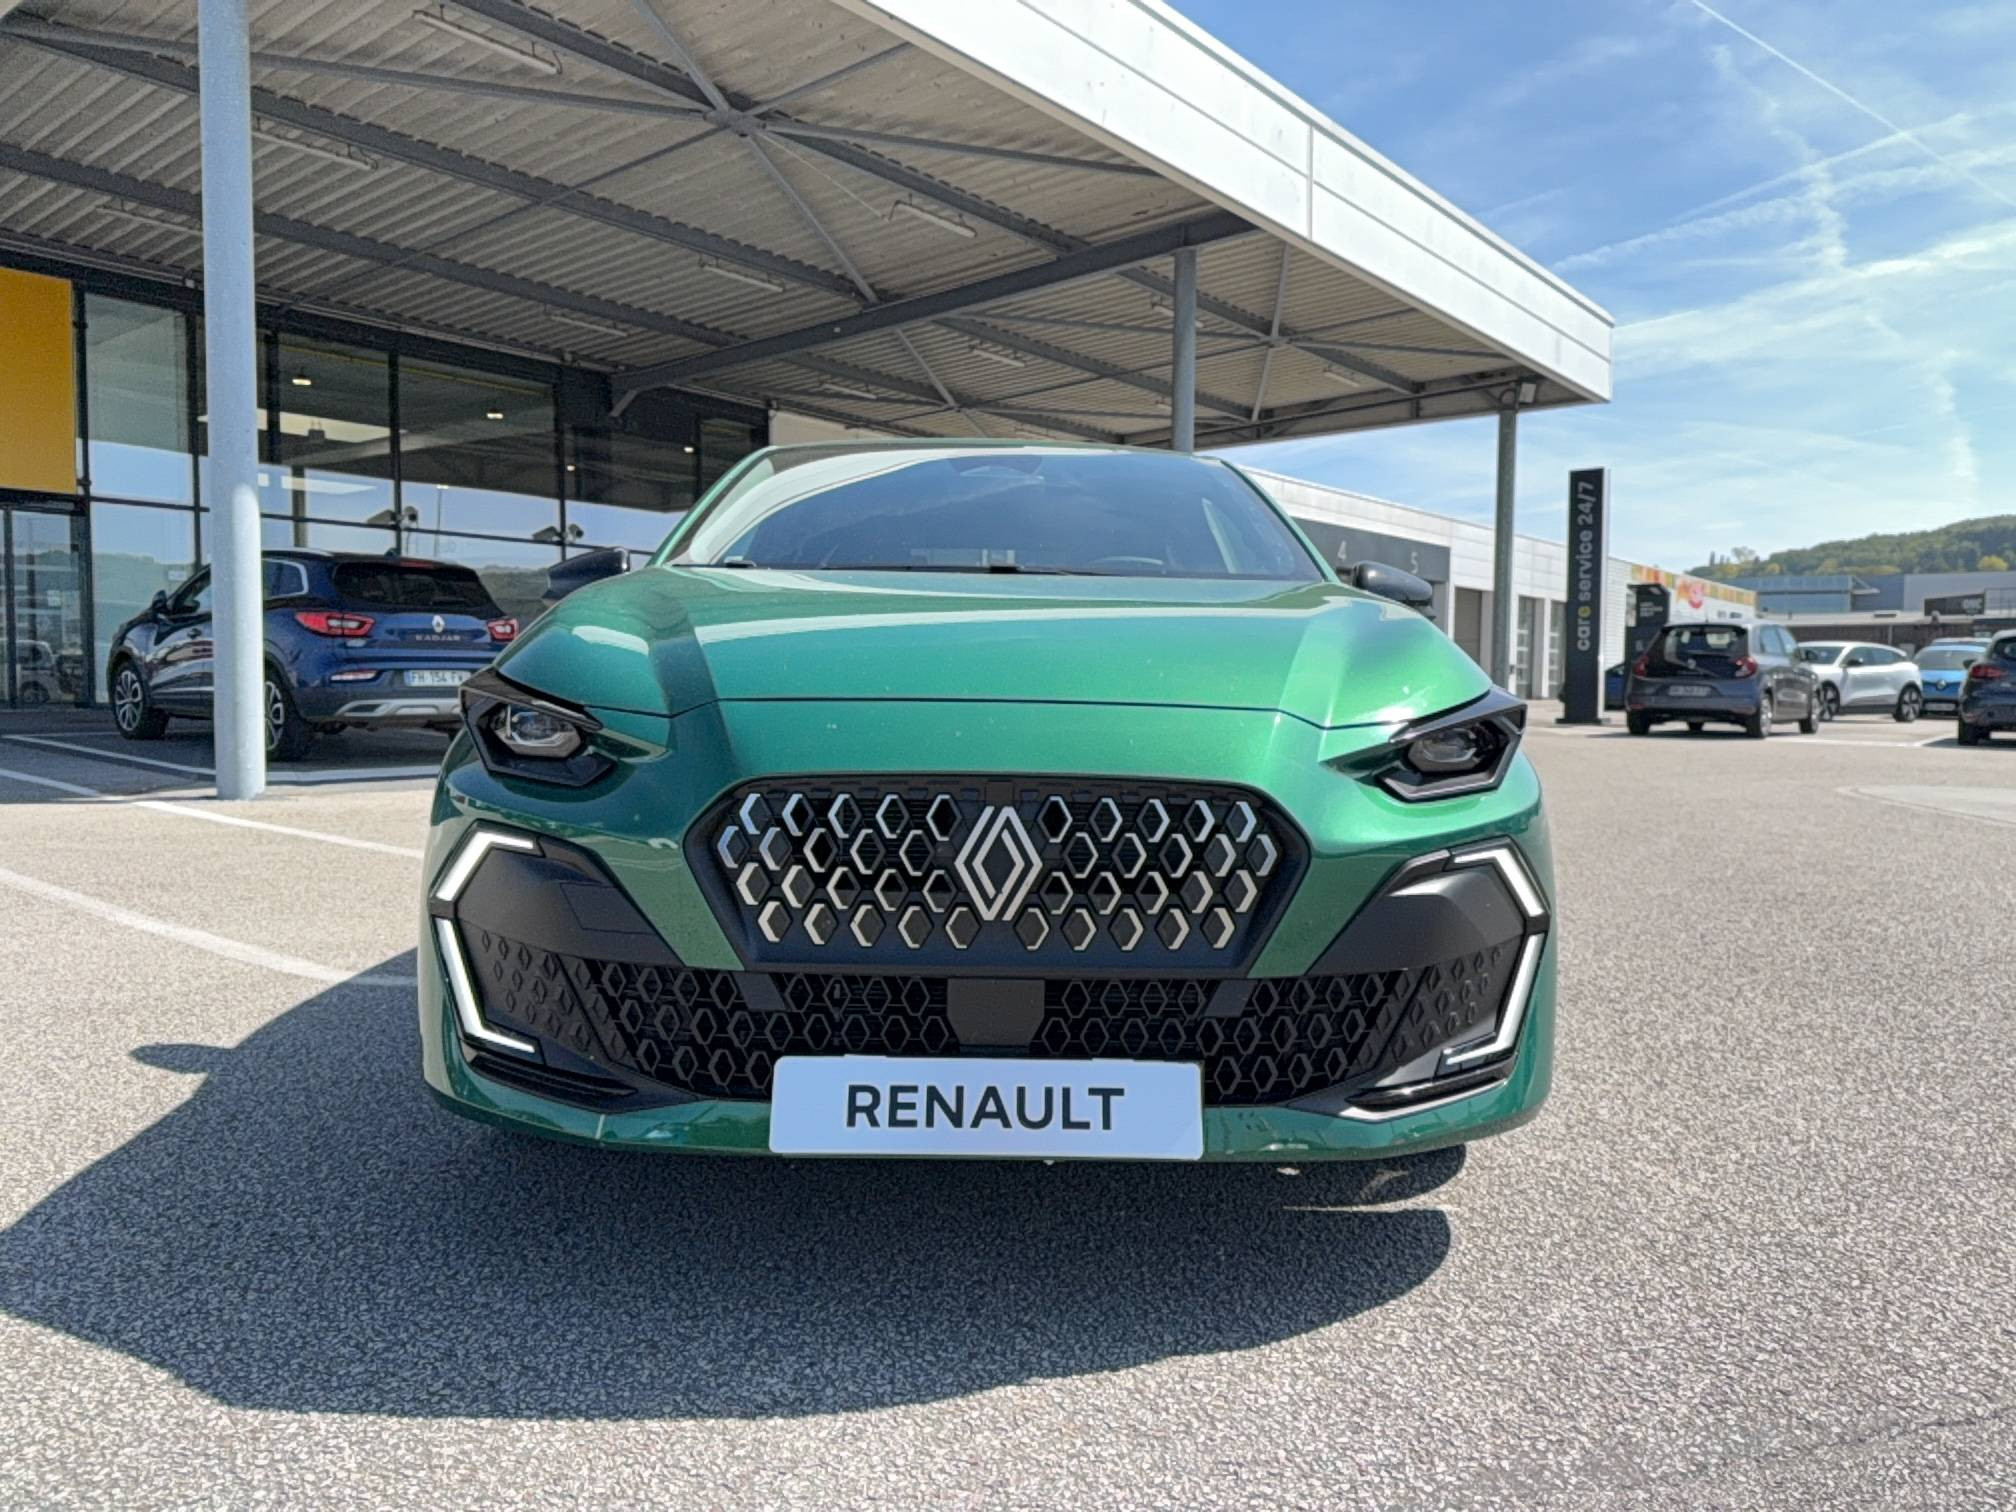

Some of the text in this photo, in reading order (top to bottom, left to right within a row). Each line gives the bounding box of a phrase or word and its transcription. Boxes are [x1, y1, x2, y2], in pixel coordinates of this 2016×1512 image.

[1337, 540, 1347, 560] 4
[1411, 551, 1419, 574] 5
[1575, 480, 1597, 651] care service 24/7
[846, 1084, 1125, 1131] RENAULT
